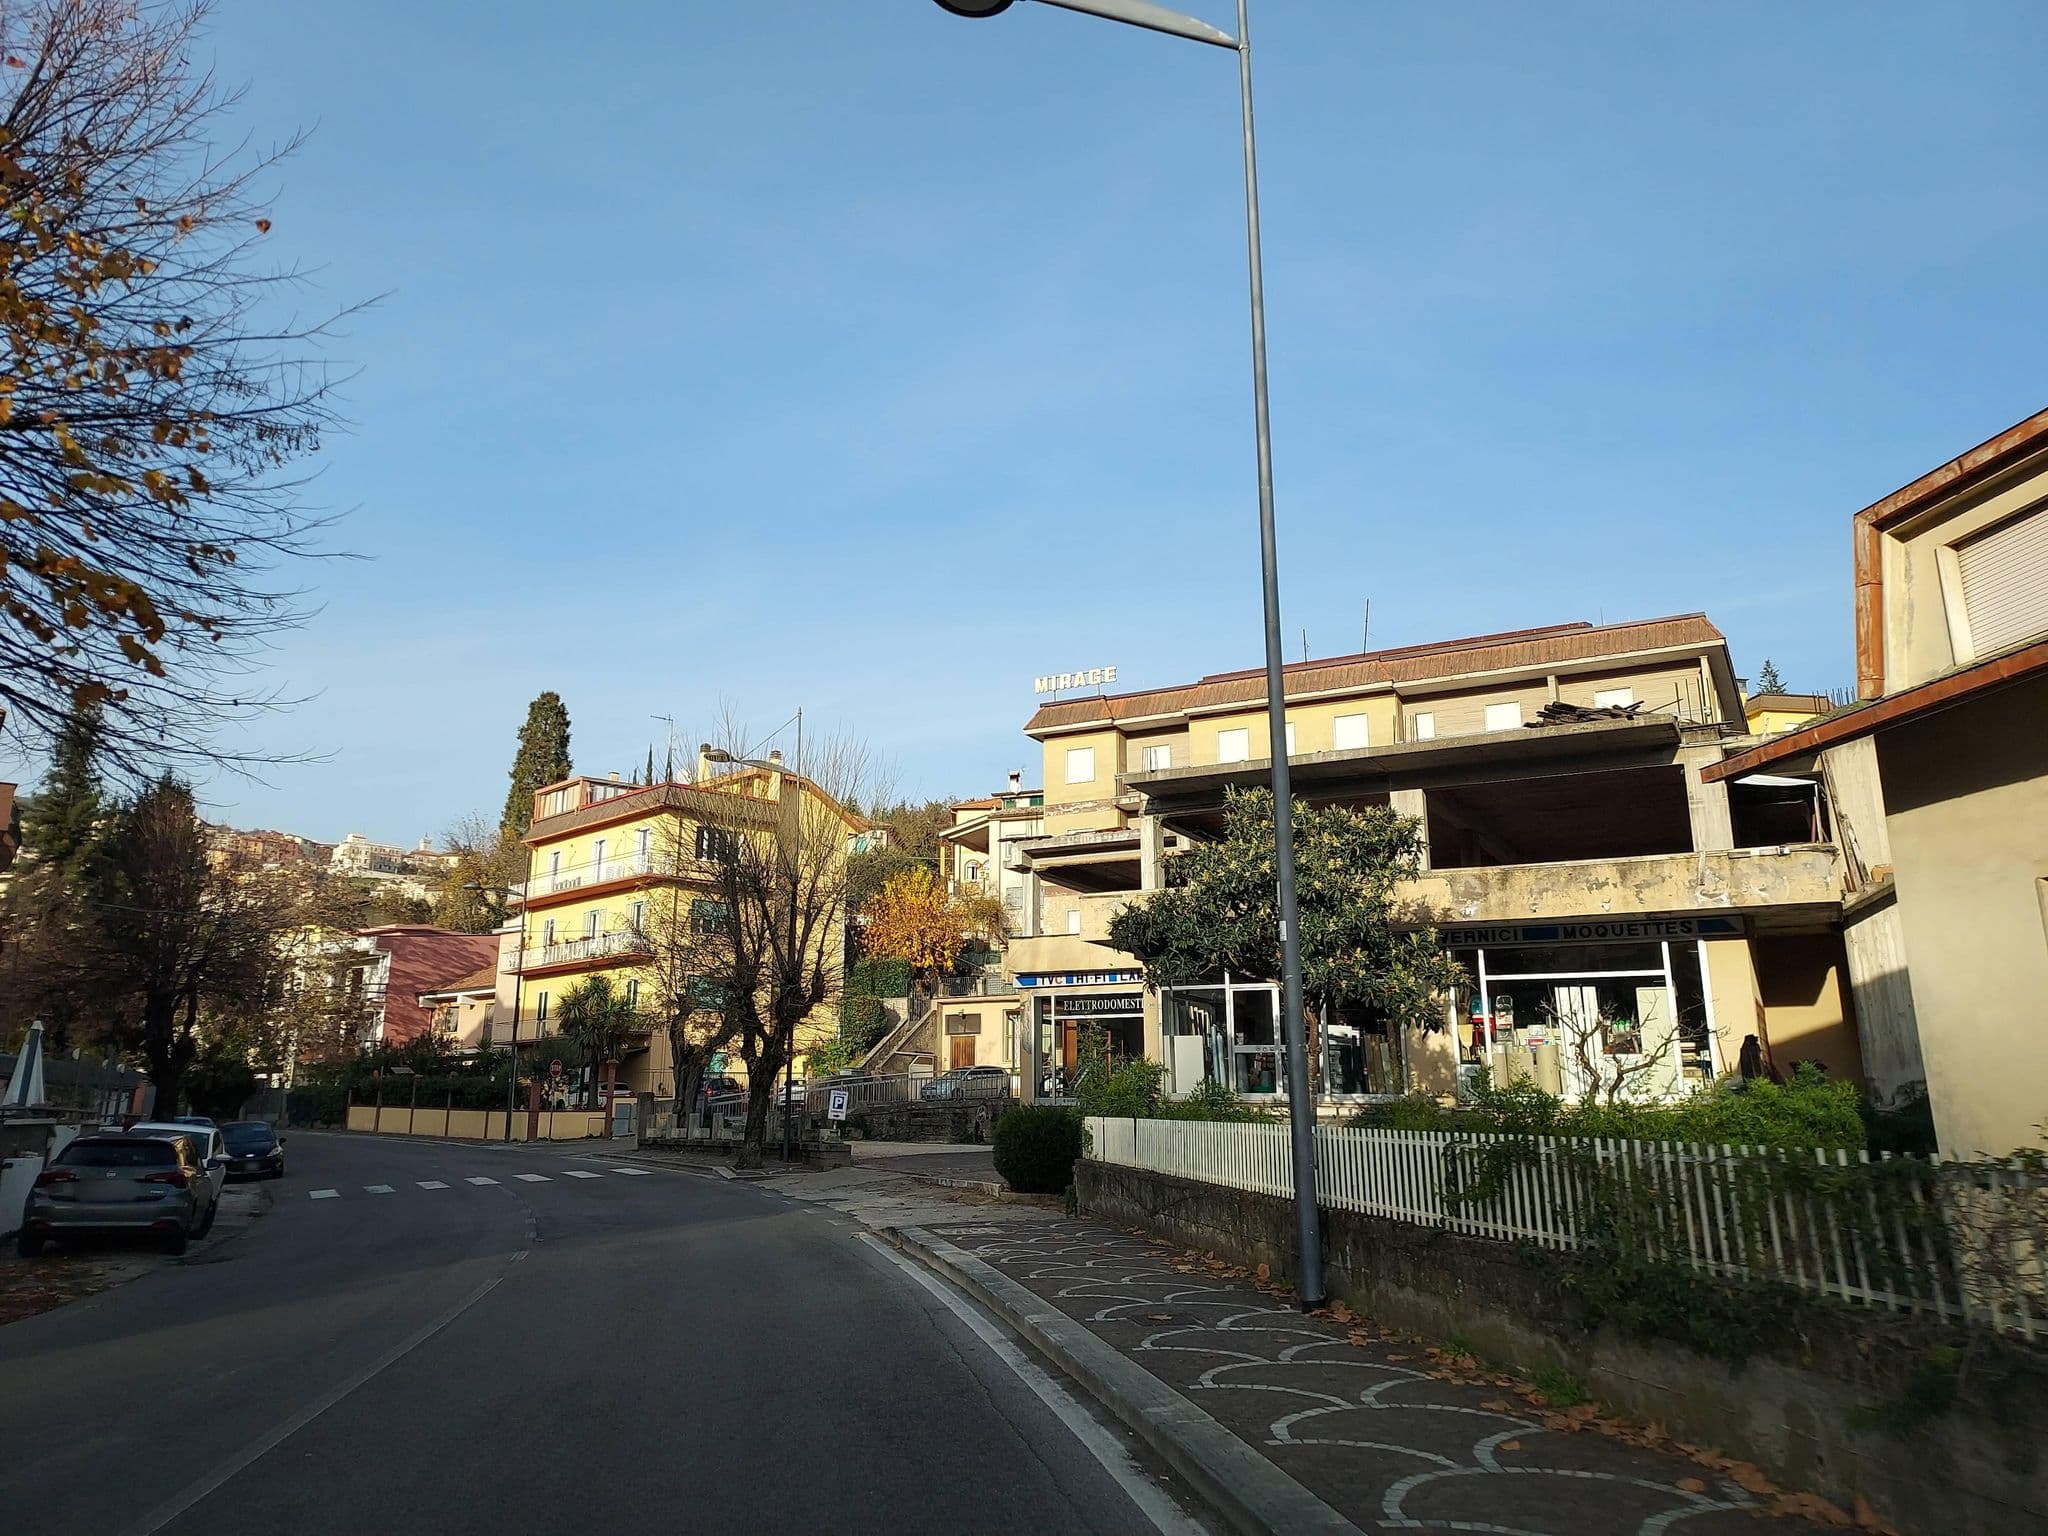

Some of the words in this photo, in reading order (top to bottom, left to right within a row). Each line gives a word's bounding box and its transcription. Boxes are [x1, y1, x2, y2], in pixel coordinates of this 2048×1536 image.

[1034, 665, 1117, 694] MIRAGE
[1562, 920, 1693, 939] MOQUETTES
[1041, 975, 1063, 986] TVC
[834, 1096, 843, 1109] P
